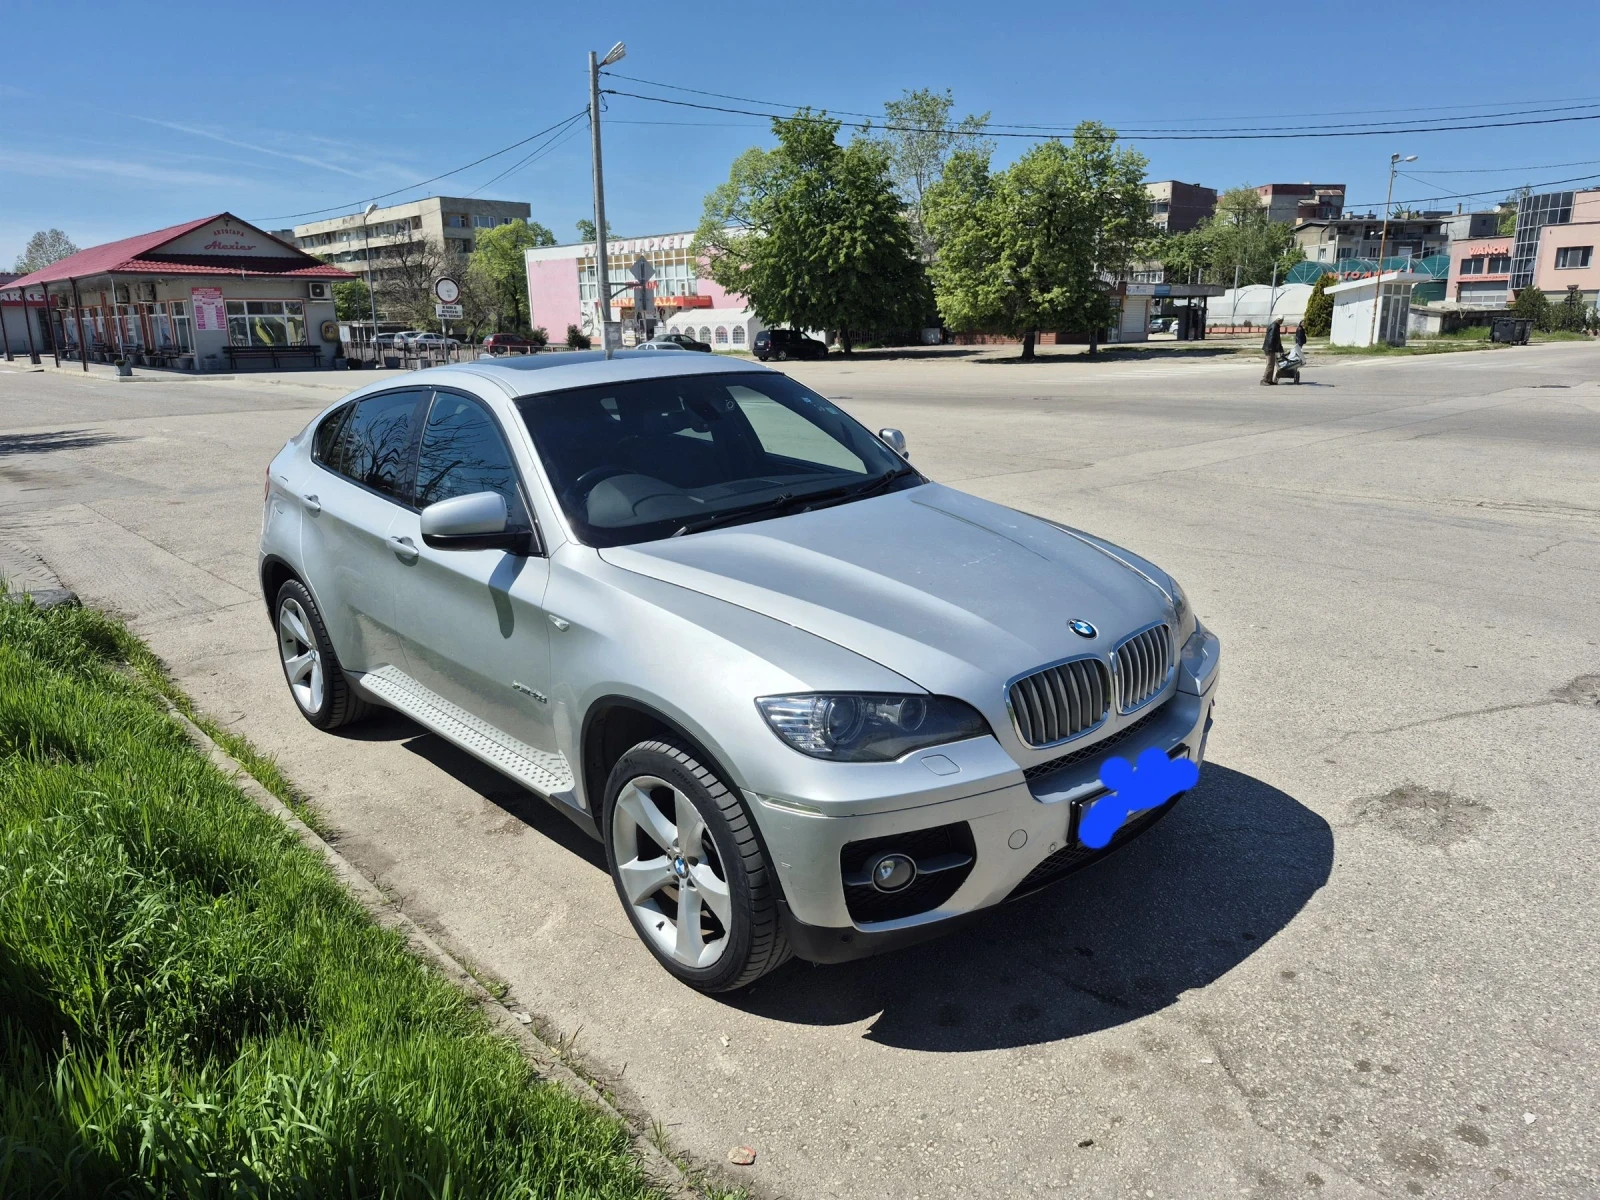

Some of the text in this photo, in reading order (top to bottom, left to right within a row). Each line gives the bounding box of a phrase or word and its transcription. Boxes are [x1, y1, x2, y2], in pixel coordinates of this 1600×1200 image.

[213, 229, 245, 237] АВТОГАРА
[204, 240, 257, 251] Alexiev
[583, 233, 685, 257] СУЕРМАРКЕТ
[0, 292, 51, 302] ARKE
[609, 297, 678, 308] HINA ALL
